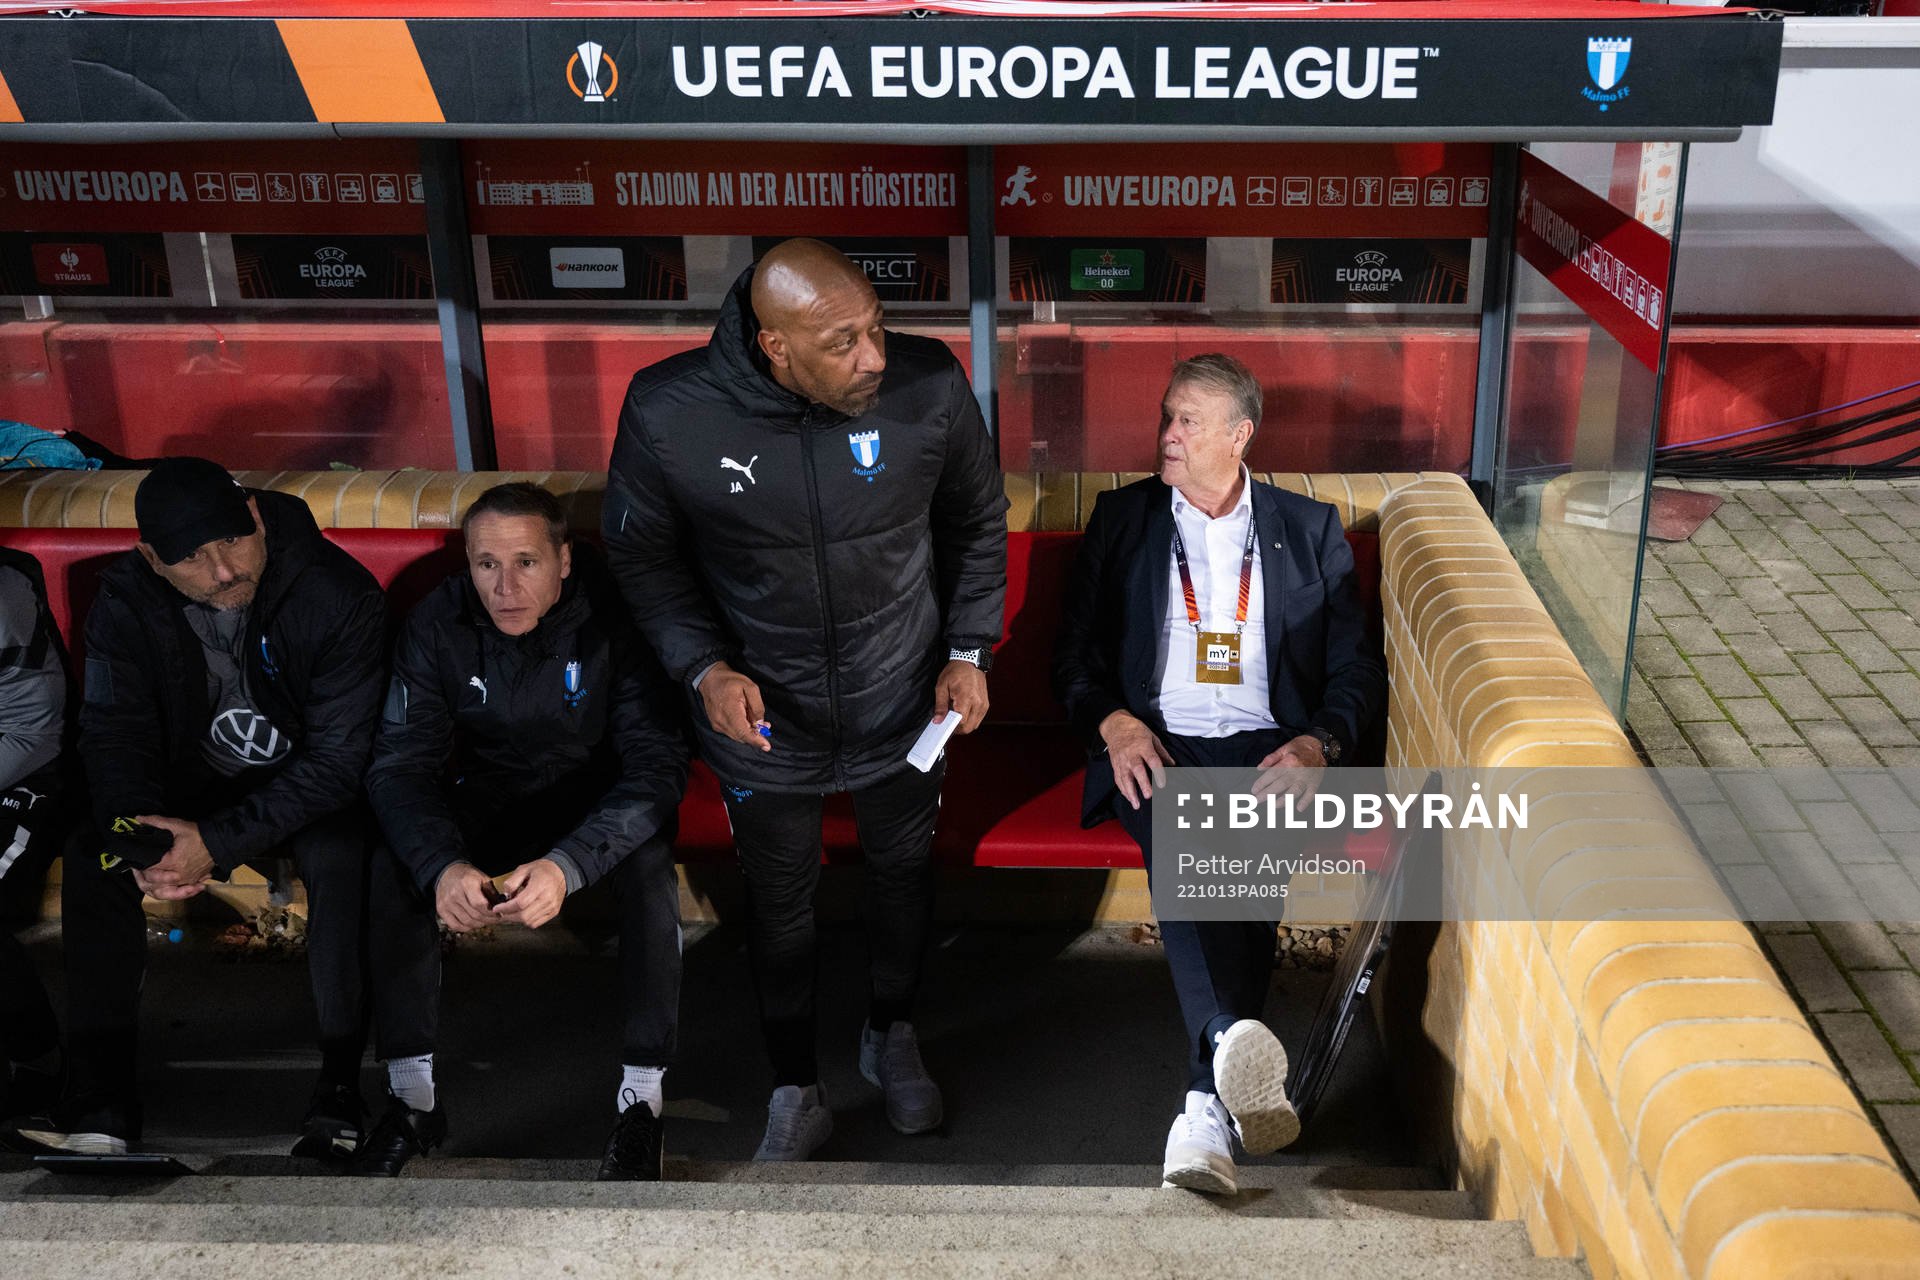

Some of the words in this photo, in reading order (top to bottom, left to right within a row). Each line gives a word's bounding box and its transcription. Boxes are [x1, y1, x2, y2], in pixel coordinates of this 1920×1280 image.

[672, 46, 853, 97] UEFA
[870, 46, 1136, 99] EUROPA
[13, 170, 189, 202] UNVEUROPA
[615, 172, 699, 207] STADION
[706, 172, 734, 207] AN
[739, 173, 778, 207] DER
[784, 173, 845, 207] ALTEN
[851, 166, 956, 207] FÖRSTEREI
[1063, 175, 1237, 207] UNVEUROPA
[316, 249, 345, 261] UEFA
[1355, 252, 1386, 265] UEFA
[299, 264, 367, 278] EUROPA
[852, 260, 917, 278] PECT
[1084, 266, 1130, 276] Heineken
[1335, 268, 1403, 282] EUROPA
[54, 273, 92, 282] STRAUSS
[730, 480, 744, 494] JA
